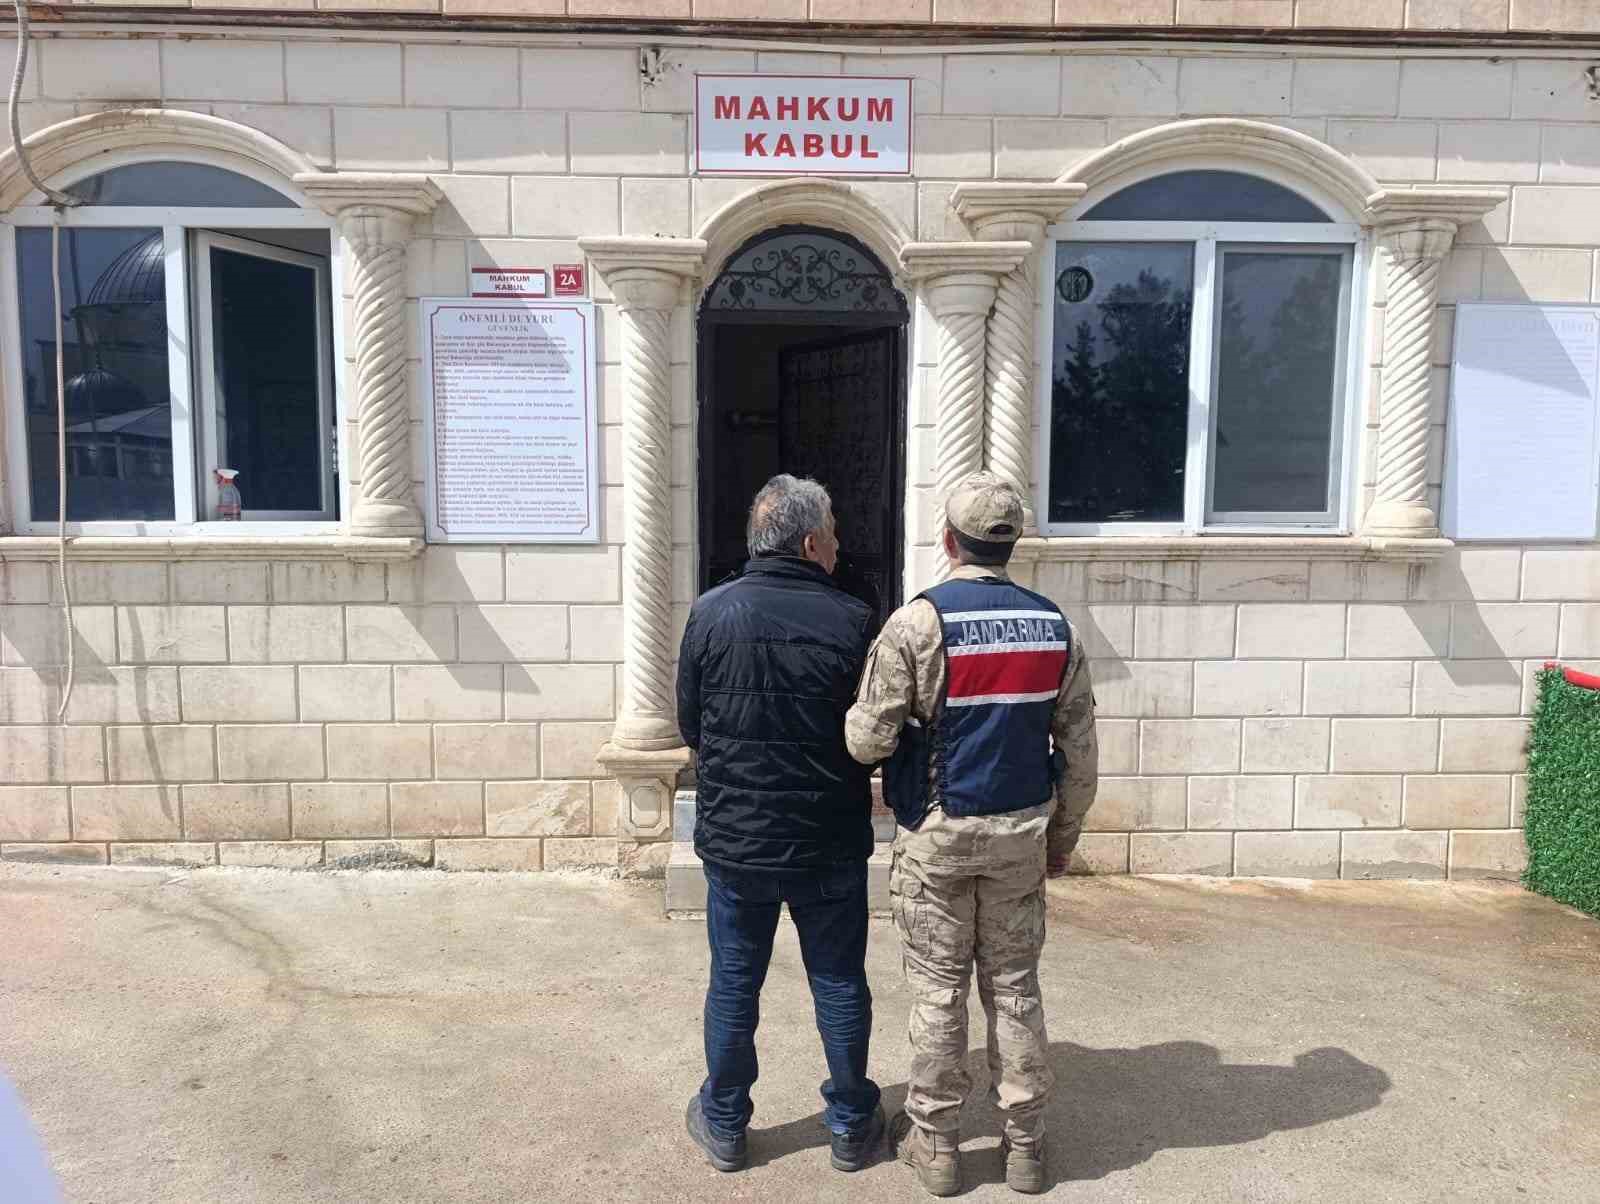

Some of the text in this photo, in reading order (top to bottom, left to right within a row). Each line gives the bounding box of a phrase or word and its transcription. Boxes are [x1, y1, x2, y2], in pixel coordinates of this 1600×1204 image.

[714, 95, 893, 122] MAHKUM
[744, 133, 879, 158] KABUL
[489, 274, 530, 282] MAHKUM
[560, 273, 576, 285] 2A
[958, 619, 1057, 645] JANDARMA
